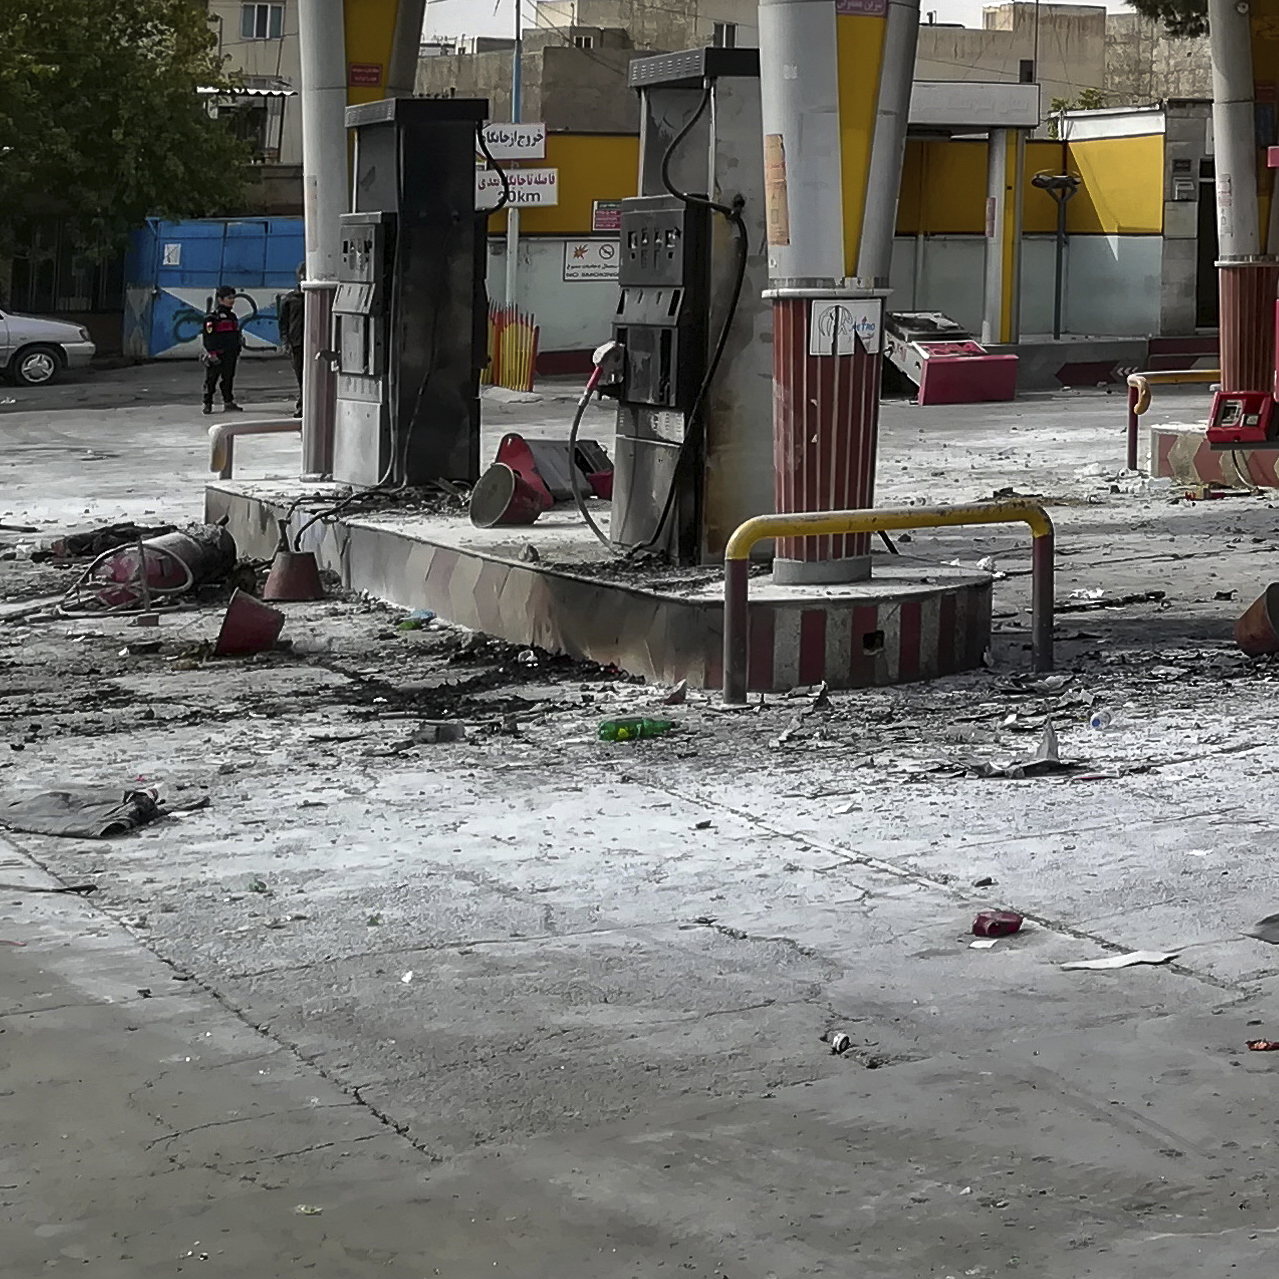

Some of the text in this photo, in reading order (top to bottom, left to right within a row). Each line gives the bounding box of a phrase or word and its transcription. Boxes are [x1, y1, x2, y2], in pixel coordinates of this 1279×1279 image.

[508, 130, 517, 147] از
[518, 128, 544, 147] خروج
[534, 172, 556, 186] فاصله
